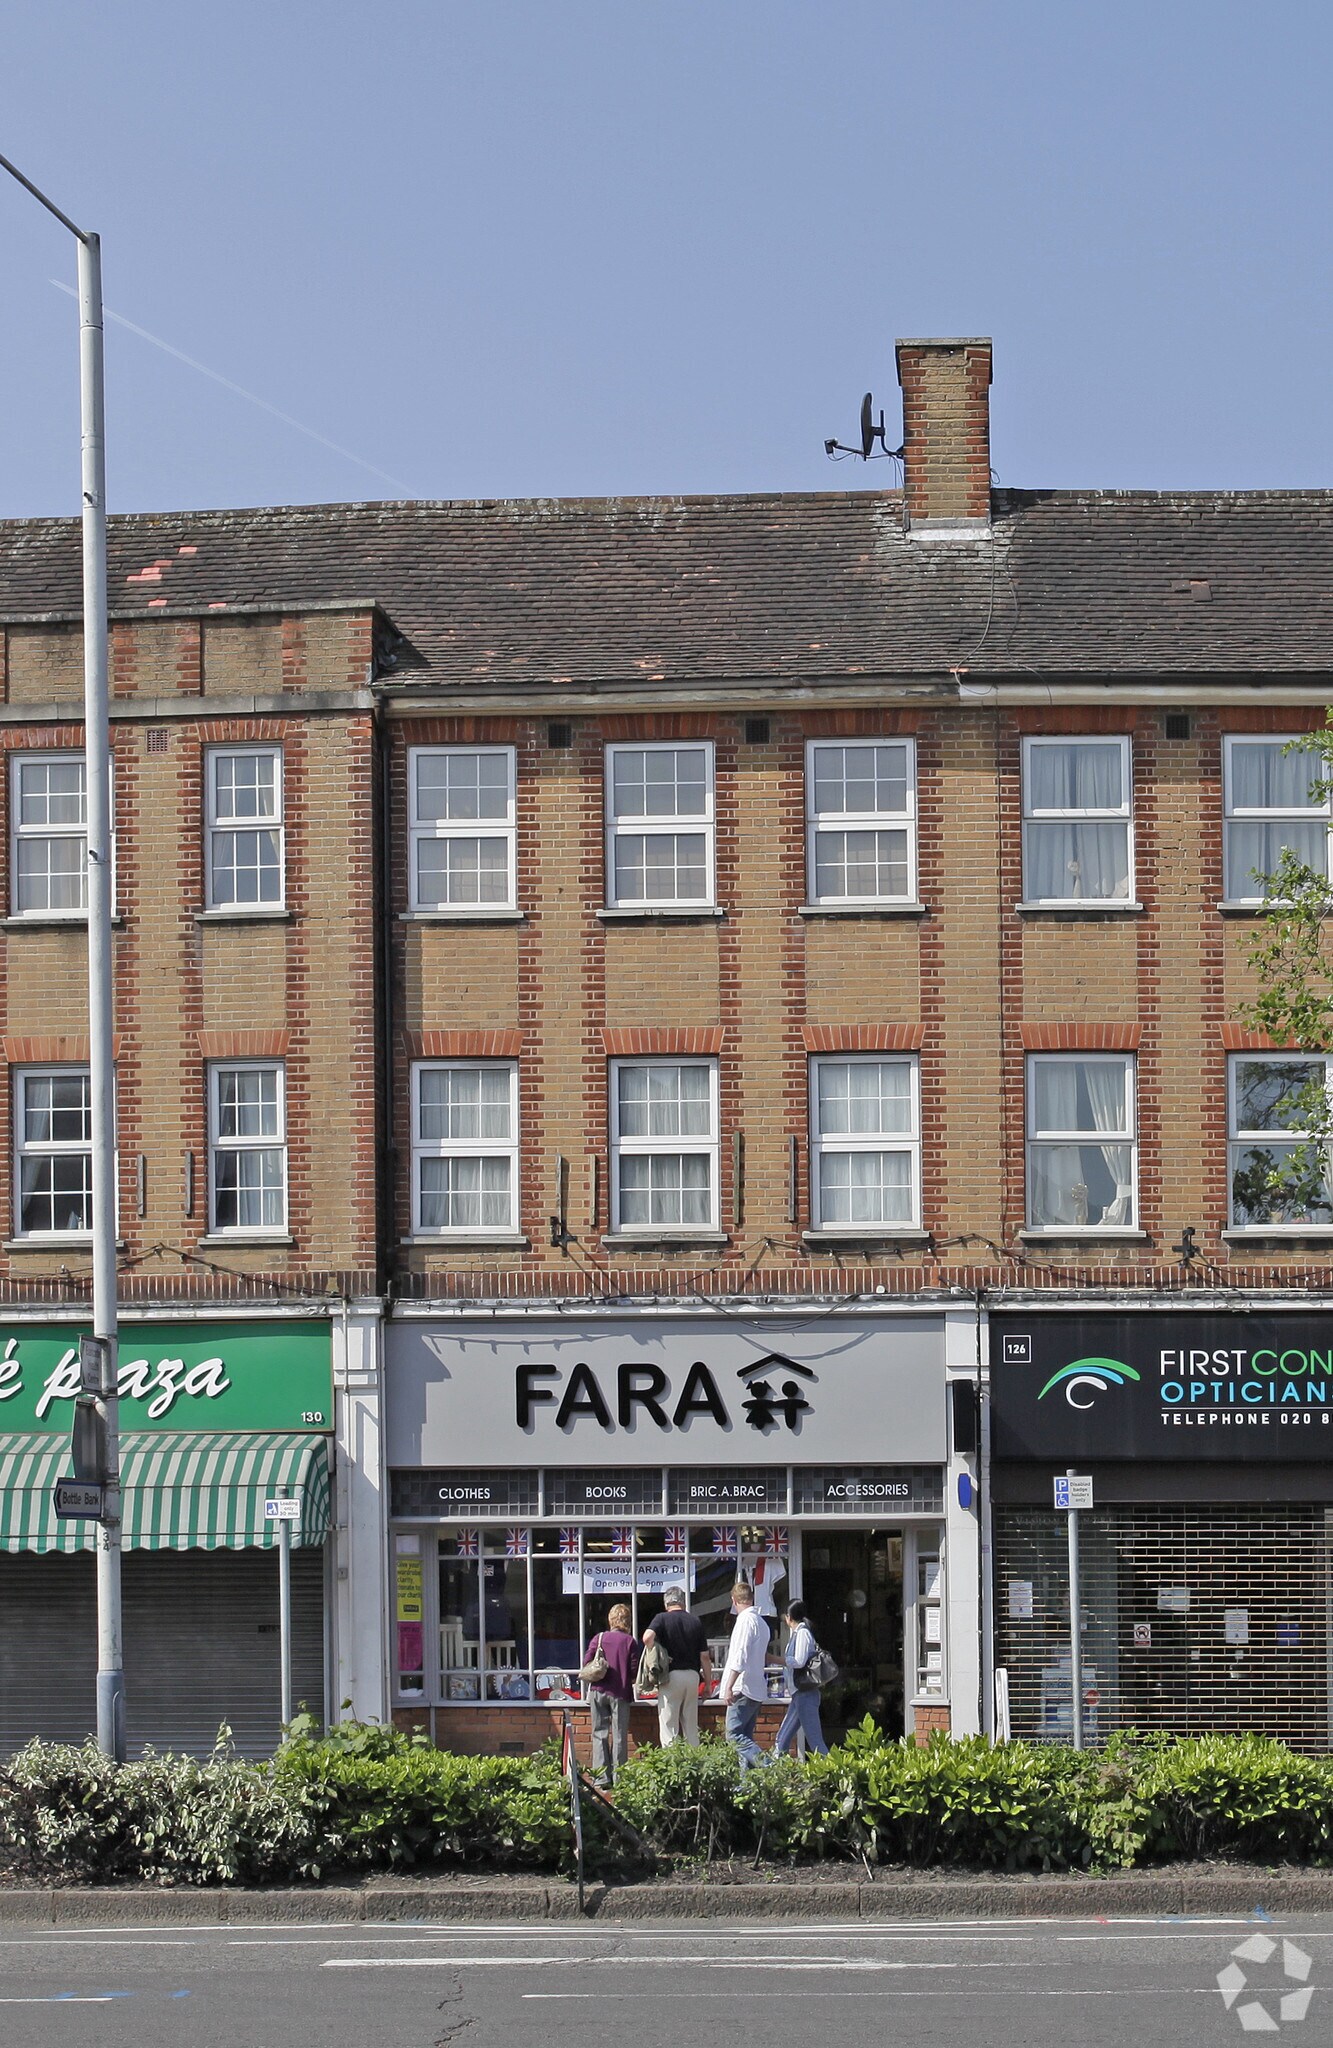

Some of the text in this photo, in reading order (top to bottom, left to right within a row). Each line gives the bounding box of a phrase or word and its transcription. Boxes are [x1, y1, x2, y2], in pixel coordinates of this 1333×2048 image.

[1007, 1344, 1026, 1354] 126
[36, 1348, 230, 1418] paza
[516, 1361, 728, 1428] FARA
[1160, 1381, 1333, 1403] OPTICIAN
[301, 1411, 322, 1422] 130
[1161, 1413, 1330, 1425] TELEPHONE 020 8
[439, 1488, 490, 1499] CLOTHES
[585, 1486, 627, 1498] BOOKS
[690, 1485, 765, 1498] BRIC.A.BRAC
[827, 1484, 909, 1496] ACCESSORIES
[62, 1491, 99, 1505] Bottle Bank
[595, 1565, 631, 1576] Sunday
[635, 1565, 660, 1574] ARA
[672, 1565, 685, 1574] Da
[595, 1579, 618, 1588] Open
[645, 1579, 664, 1589] 5pm
